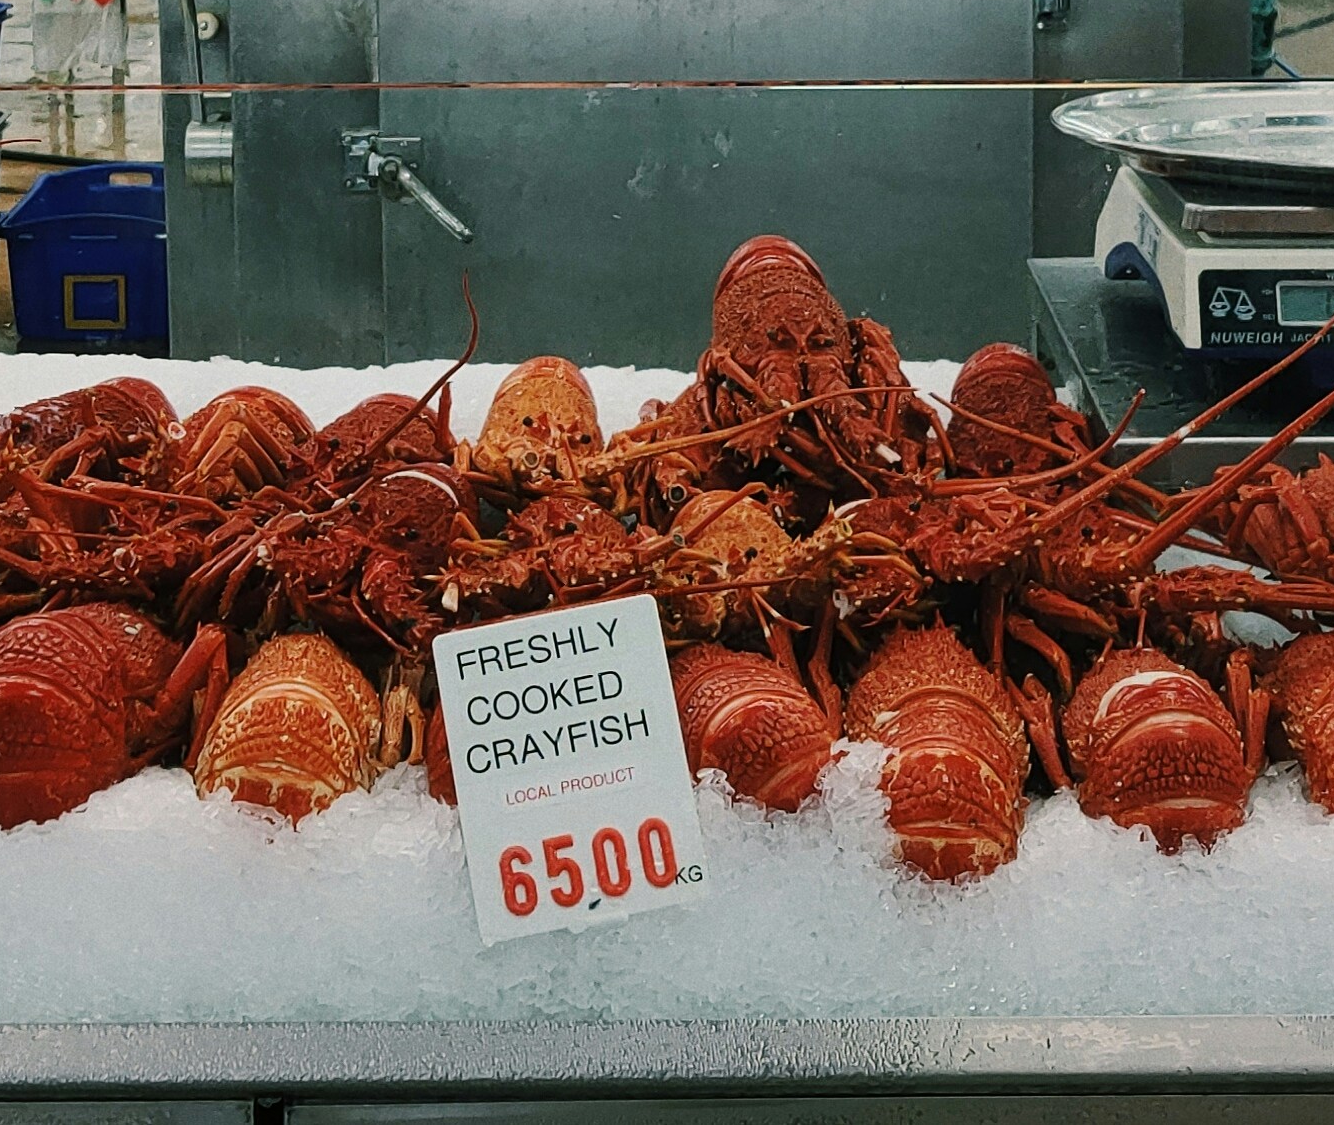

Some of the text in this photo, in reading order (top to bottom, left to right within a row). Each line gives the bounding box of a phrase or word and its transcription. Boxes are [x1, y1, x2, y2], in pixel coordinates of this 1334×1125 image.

[1210, 331, 1284, 345] NUWEIGH
[456, 618, 619, 680] FRESHLY
[467, 670, 623, 725] COOKED
[466, 708, 650, 773] CRAYFISH
[506, 766, 635, 806] LOCAL PRODUCT
[674, 865, 704, 885] KG
